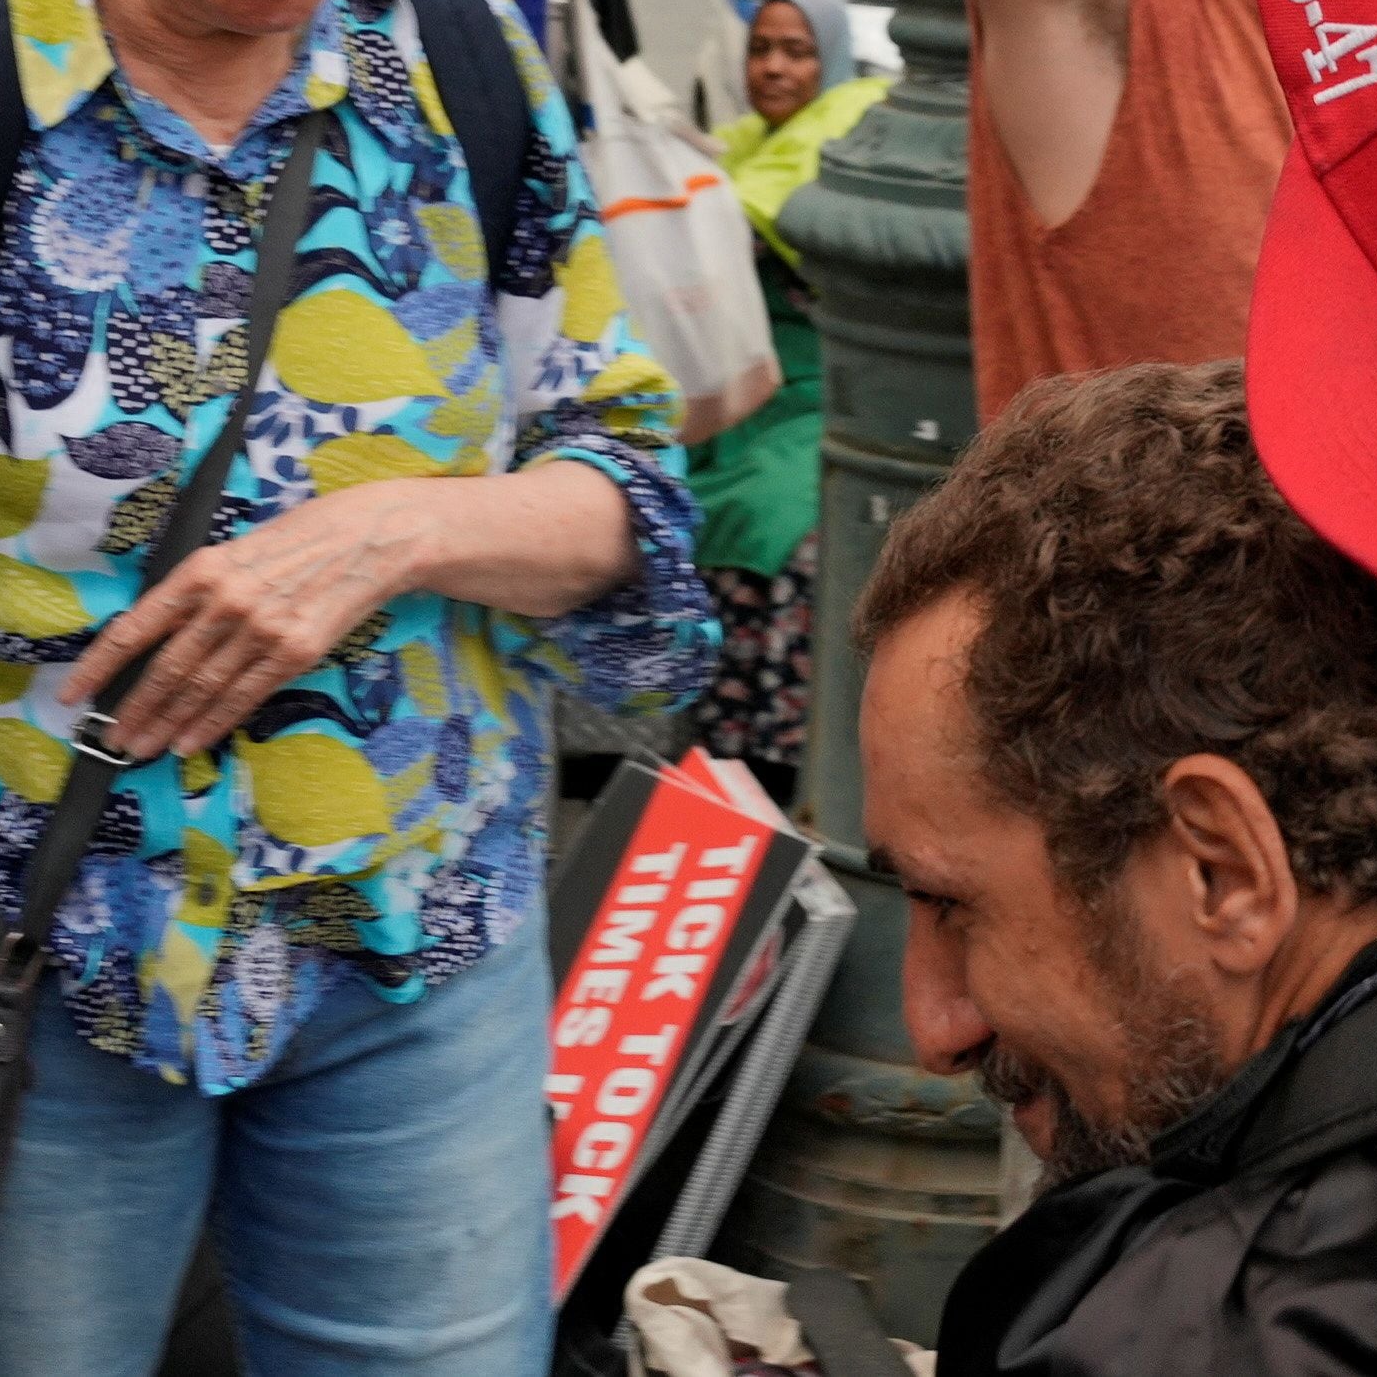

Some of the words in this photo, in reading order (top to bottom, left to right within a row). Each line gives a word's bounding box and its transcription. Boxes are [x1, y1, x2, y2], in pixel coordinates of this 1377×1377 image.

[554, 840, 688, 1050] TIMES
[640, 833, 759, 1002] TICK
[550, 1023, 682, 1224] TOCK
